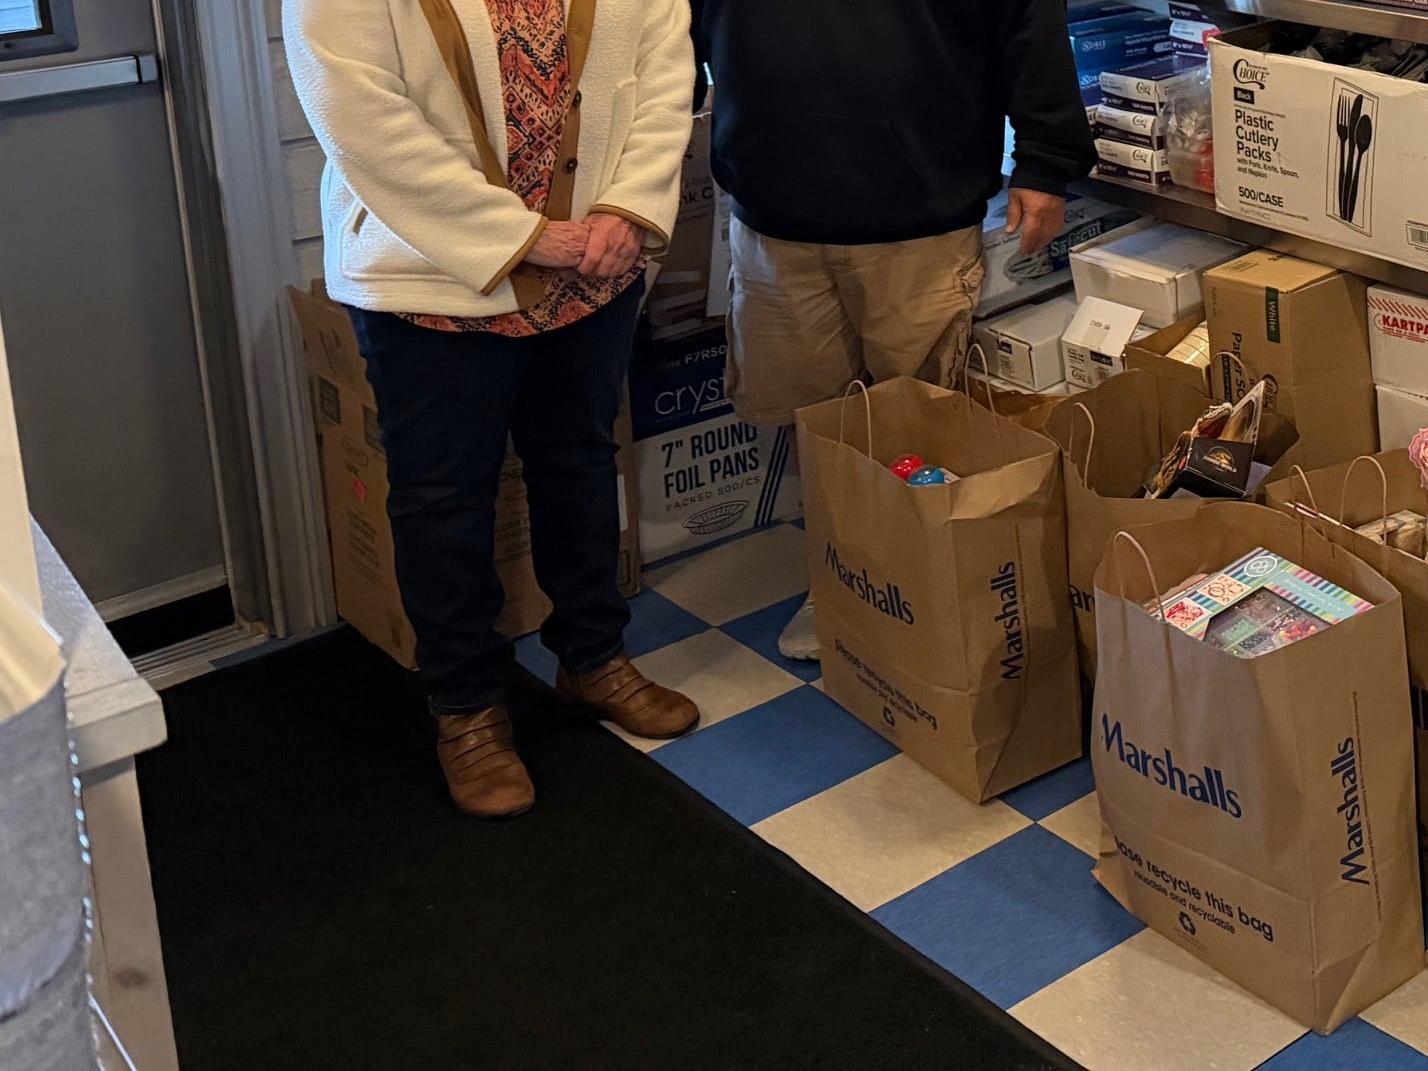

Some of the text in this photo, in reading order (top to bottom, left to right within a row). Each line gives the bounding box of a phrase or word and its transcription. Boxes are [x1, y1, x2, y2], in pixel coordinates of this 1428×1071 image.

[1235, 109, 1274, 131] Plastic
[1236, 126, 1279, 151] Cutlery
[1237, 141, 1272, 163] Packs
[1237, 166, 1267, 179] and Napkin
[1249, 159, 1300, 178] Fork, Knife, Spoon,
[1238, 186, 1284, 208] 500/CASE
[1267, 301, 1277, 332] White
[1232, 332, 1242, 374] Paper
[661, 423, 758, 468] 7" ROUND
[664, 448, 760, 498] FOIL PANS
[666, 490, 713, 513] PACKED
[825, 541, 914, 626] Marshalls
[990, 561, 1024, 681] Marshalls
[1101, 712, 1242, 819] Marshalls
[1330, 736, 1370, 885] Marshalls
[1134, 870, 1236, 935] reusable and recyclable
[1147, 861, 1274, 942] recycle this bag
